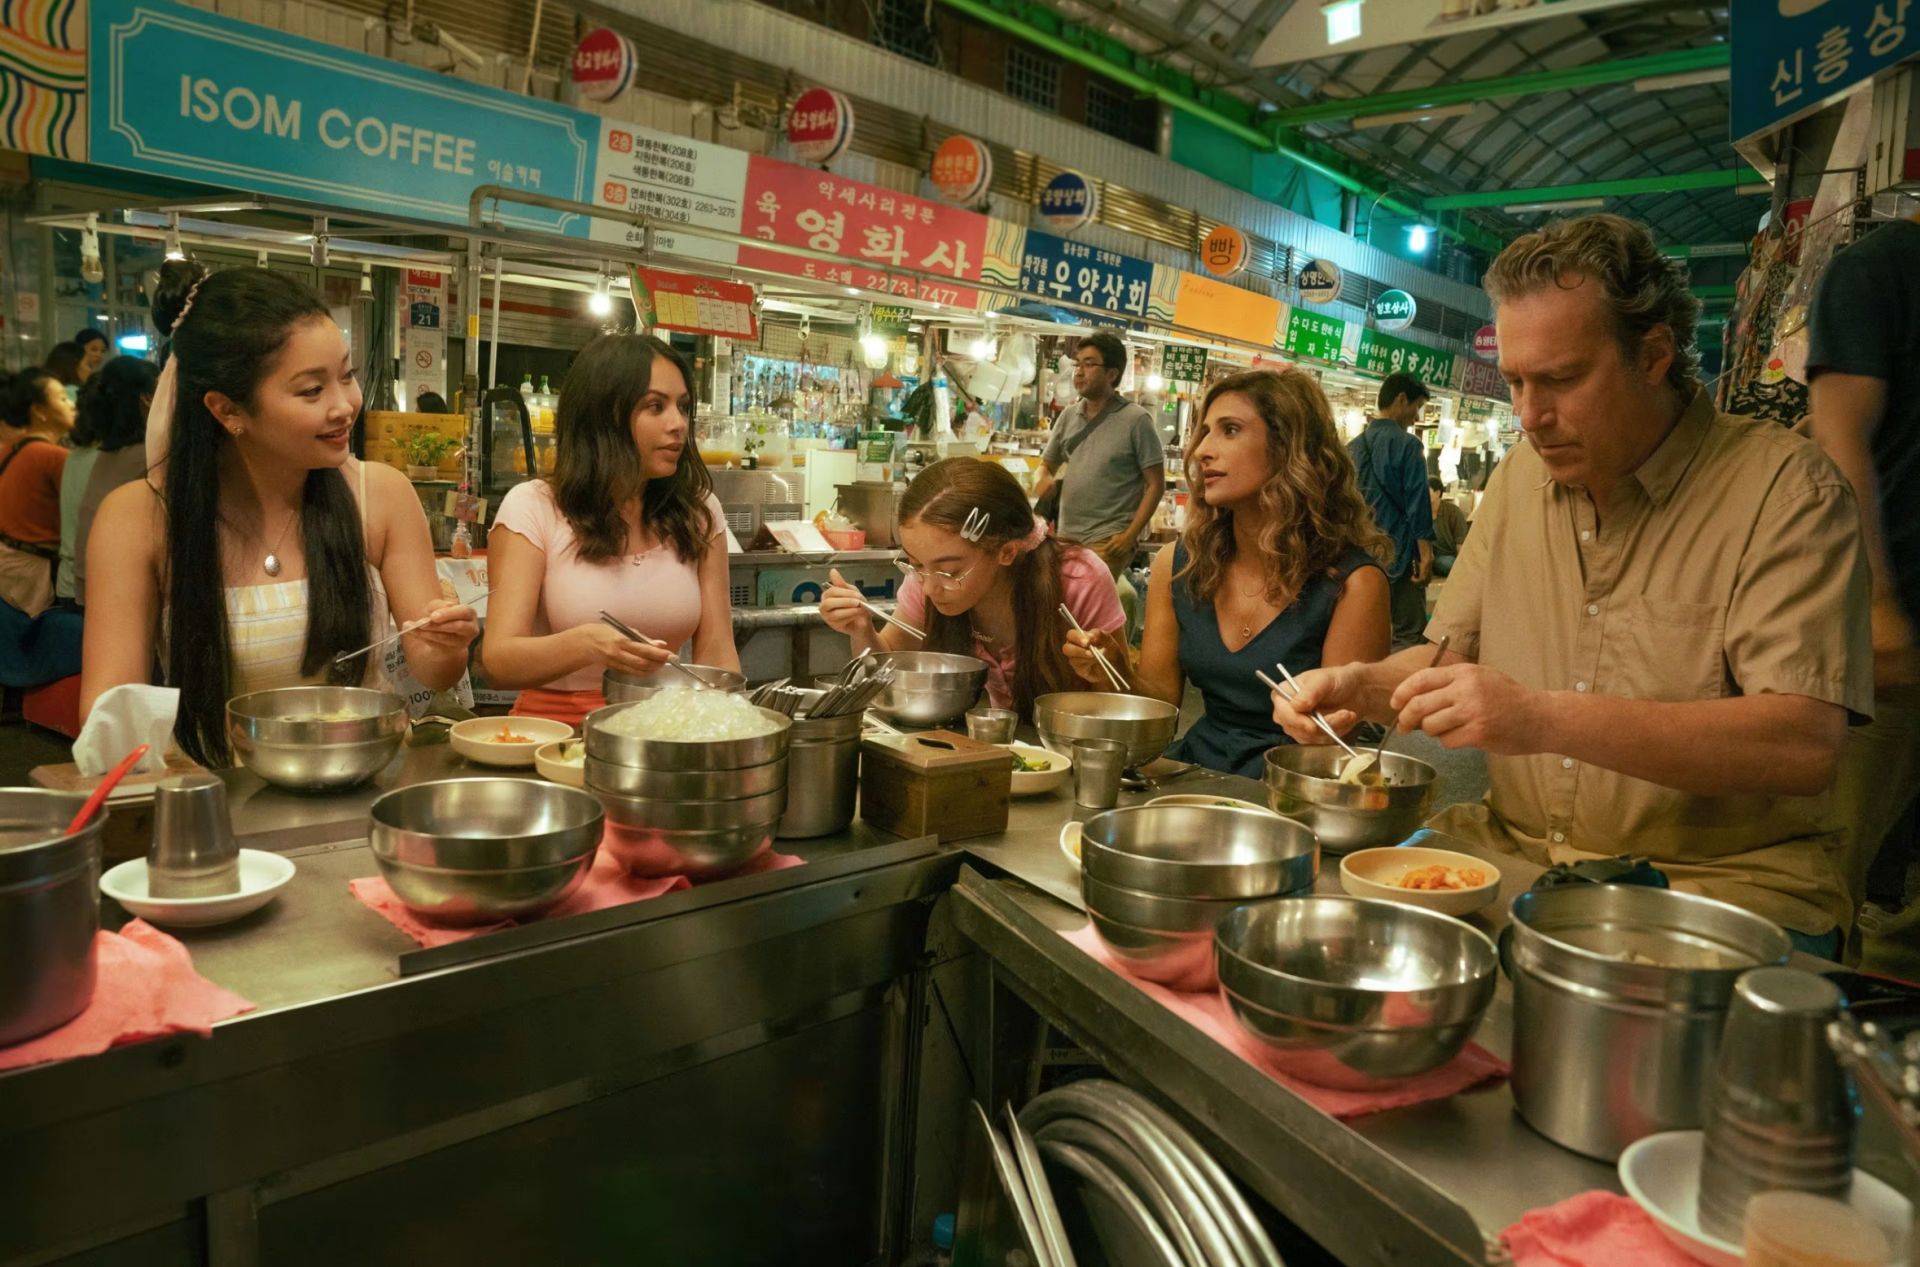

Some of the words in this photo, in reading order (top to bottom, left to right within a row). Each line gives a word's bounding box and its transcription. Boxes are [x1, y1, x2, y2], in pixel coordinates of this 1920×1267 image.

[179, 74, 302, 140] ISOM
[317, 108, 477, 176] COFFEE
[1209, 238, 1236, 266] 빵
[867, 275, 959, 306] 2273-7477
[1049, 260, 1147, 317] 우양상회
[418, 313, 431, 326] 21
